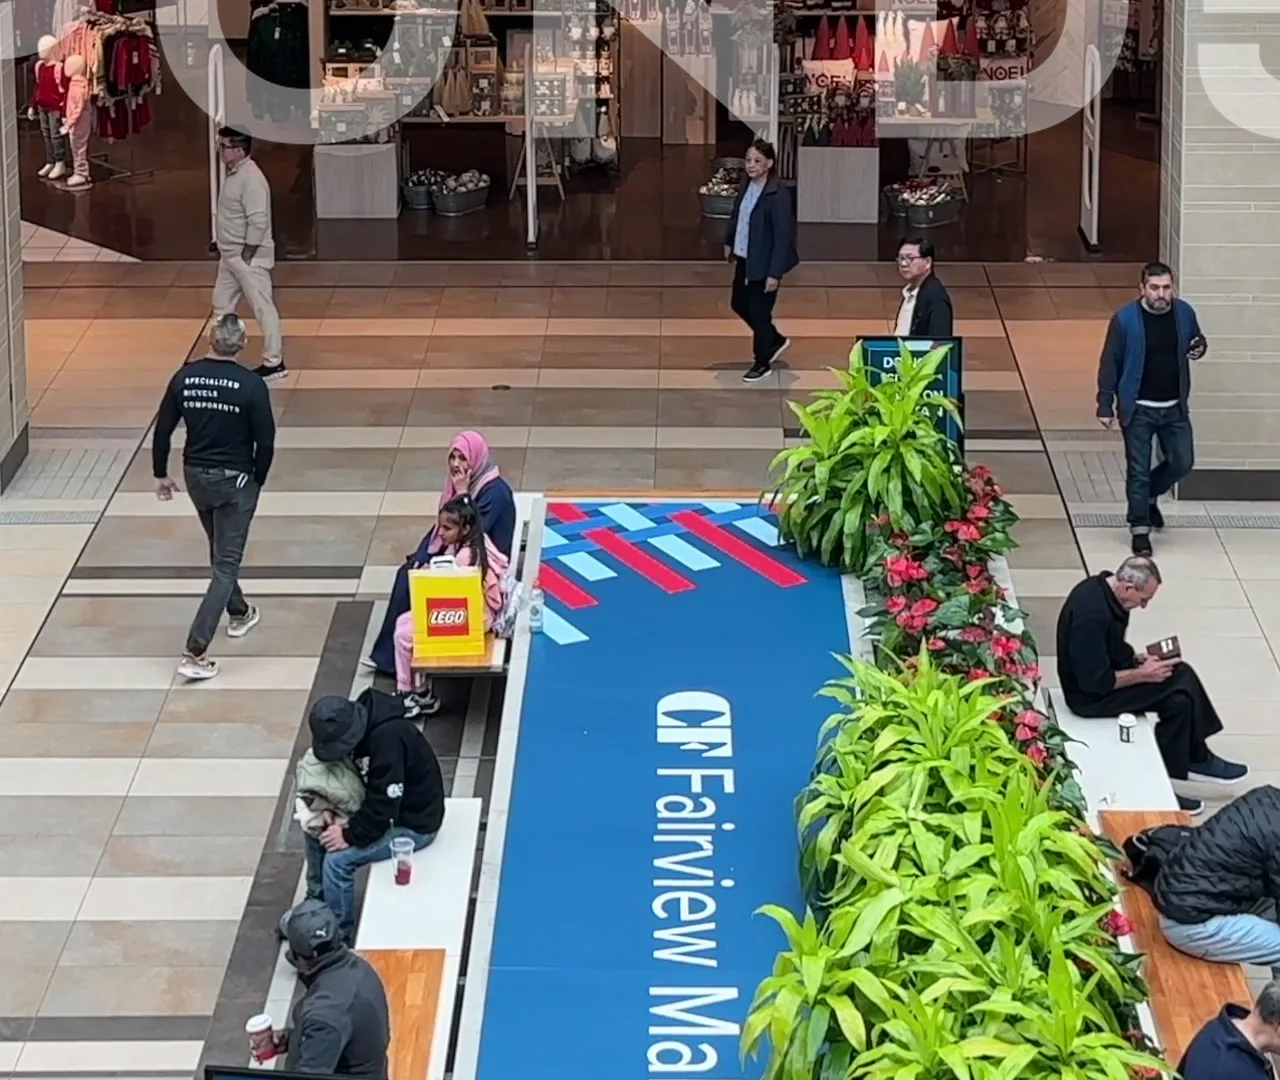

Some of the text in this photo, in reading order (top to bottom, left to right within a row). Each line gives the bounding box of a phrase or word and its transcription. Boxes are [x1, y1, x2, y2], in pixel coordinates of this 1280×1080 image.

[184, 376, 240, 389] SPECIALIZED
[183, 389, 219, 398] BICYCLE
[430, 609, 465, 625] LEGO
[651, 767, 736, 968] Fairview
[646, 985, 742, 1080] Ma
